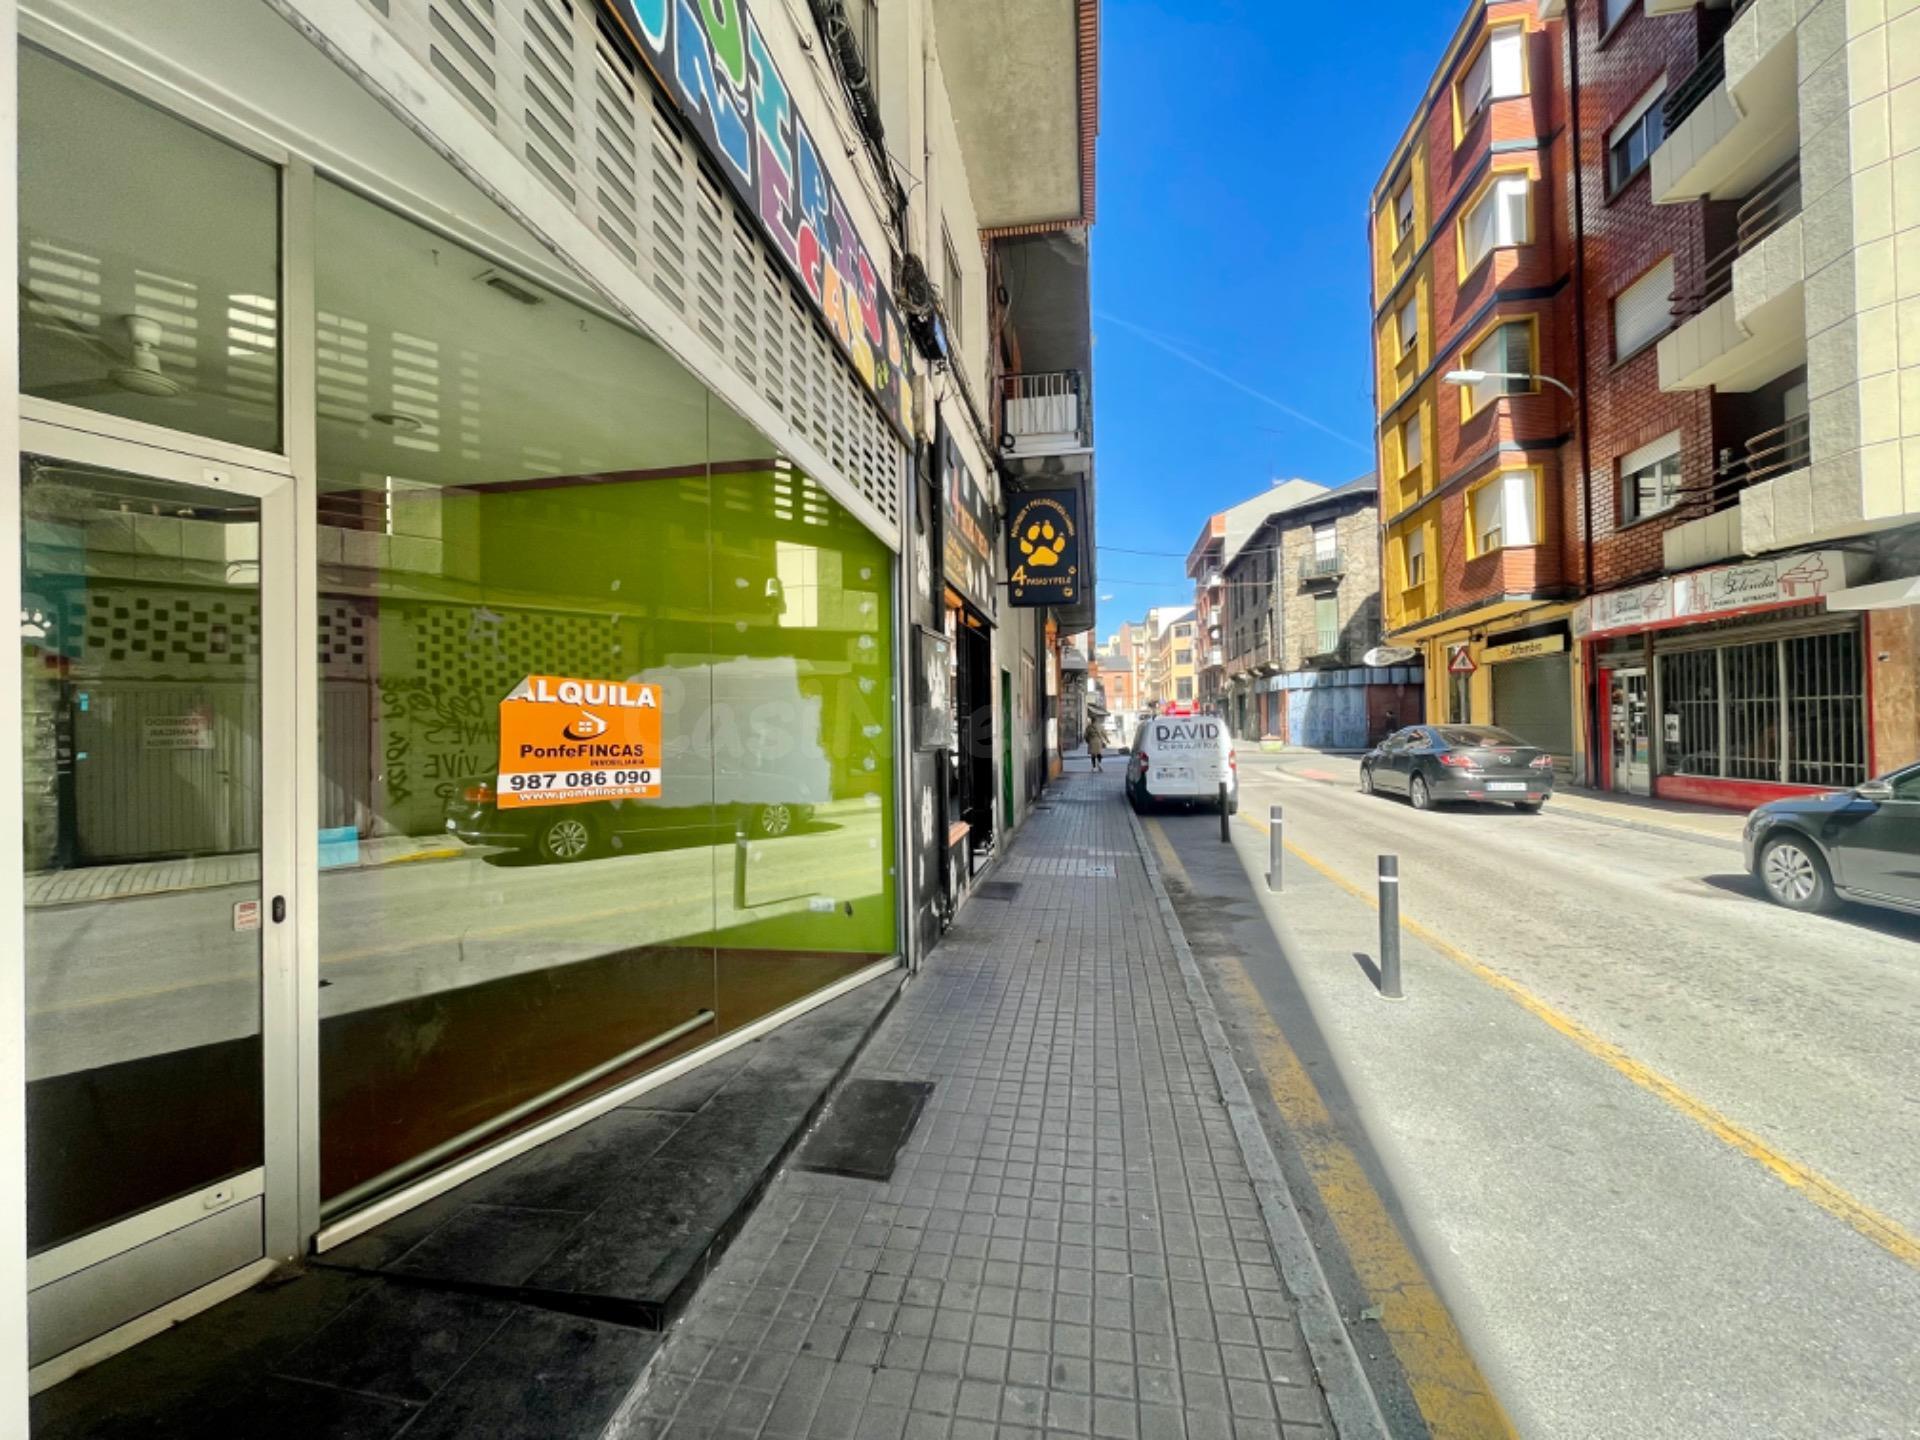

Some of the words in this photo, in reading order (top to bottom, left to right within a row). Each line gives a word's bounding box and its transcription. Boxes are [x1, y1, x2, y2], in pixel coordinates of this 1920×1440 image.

[1155, 723, 1219, 741] DAVID
[520, 744, 644, 759] PonfeFINCAS
[510, 774, 556, 791] 987
[566, 772, 606, 787] 086
[615, 771, 650, 784] 090
[519, 786, 647, 801] www.ponfefincas.es
